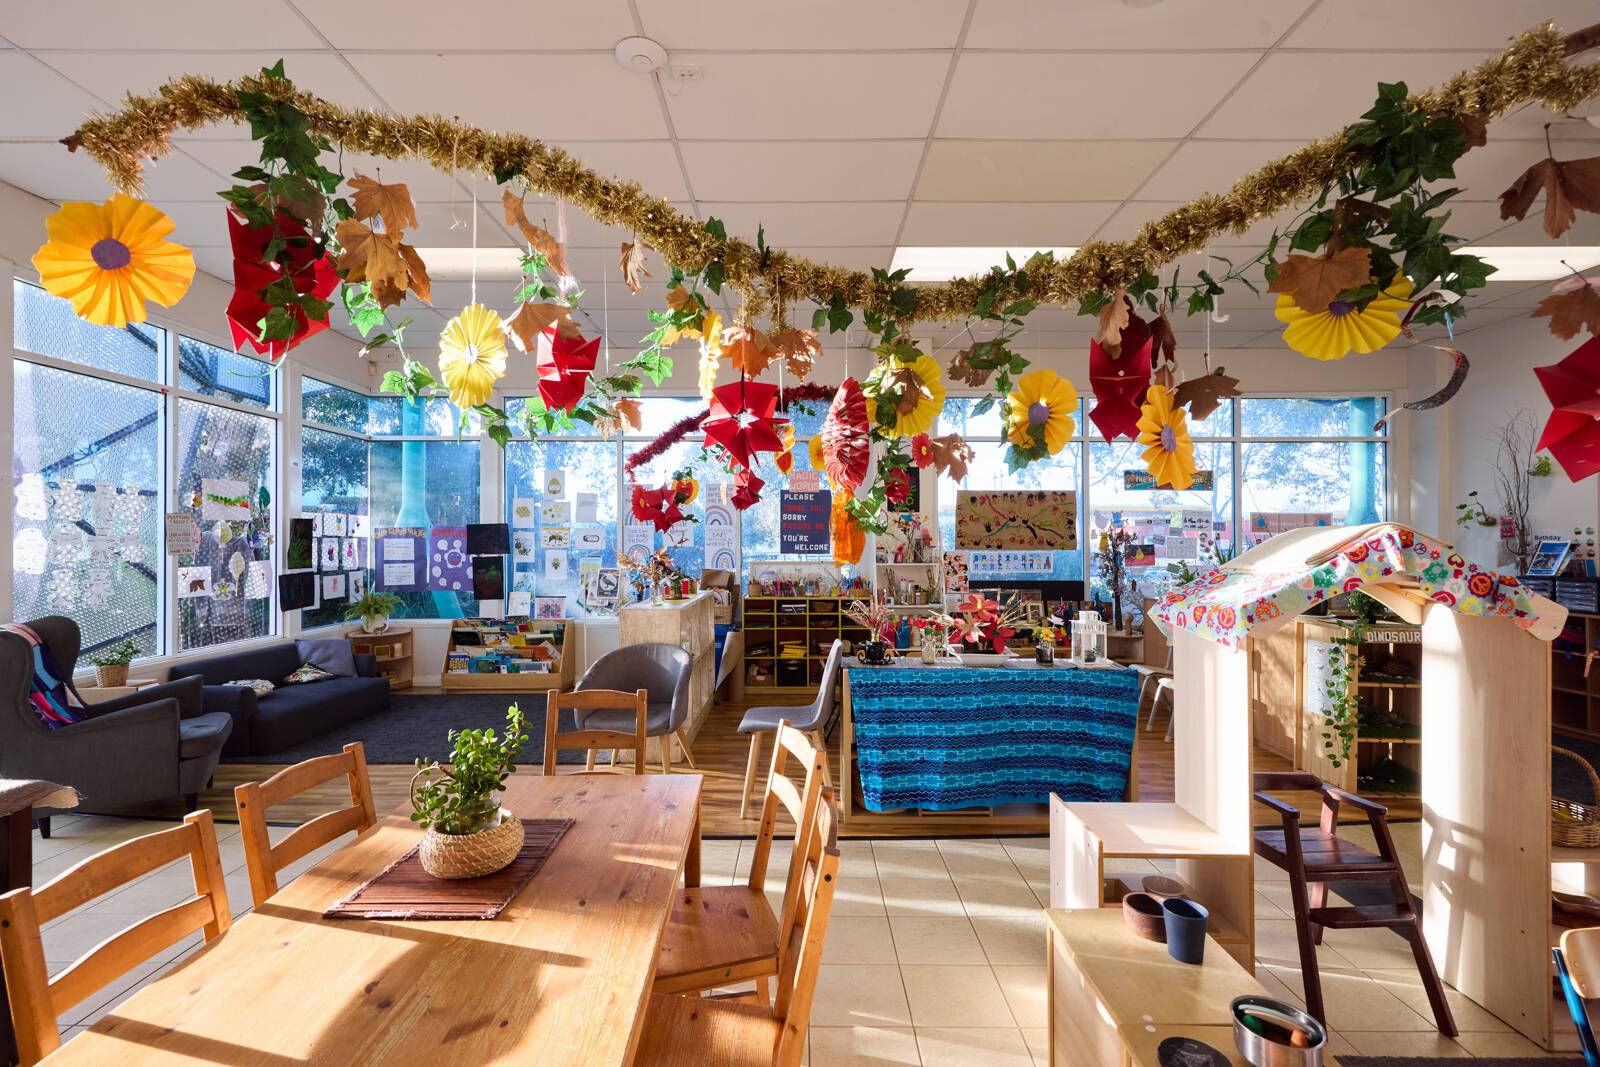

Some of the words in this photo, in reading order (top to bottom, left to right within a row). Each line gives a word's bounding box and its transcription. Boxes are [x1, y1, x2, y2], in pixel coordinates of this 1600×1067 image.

[783, 493, 815, 501] PLEASE
[782, 513, 807, 521] SORRY
[782, 534, 809, 543] YOU'RE
[794, 543, 830, 551] WELCOME
[1367, 631, 1421, 642] DINOSAUR
